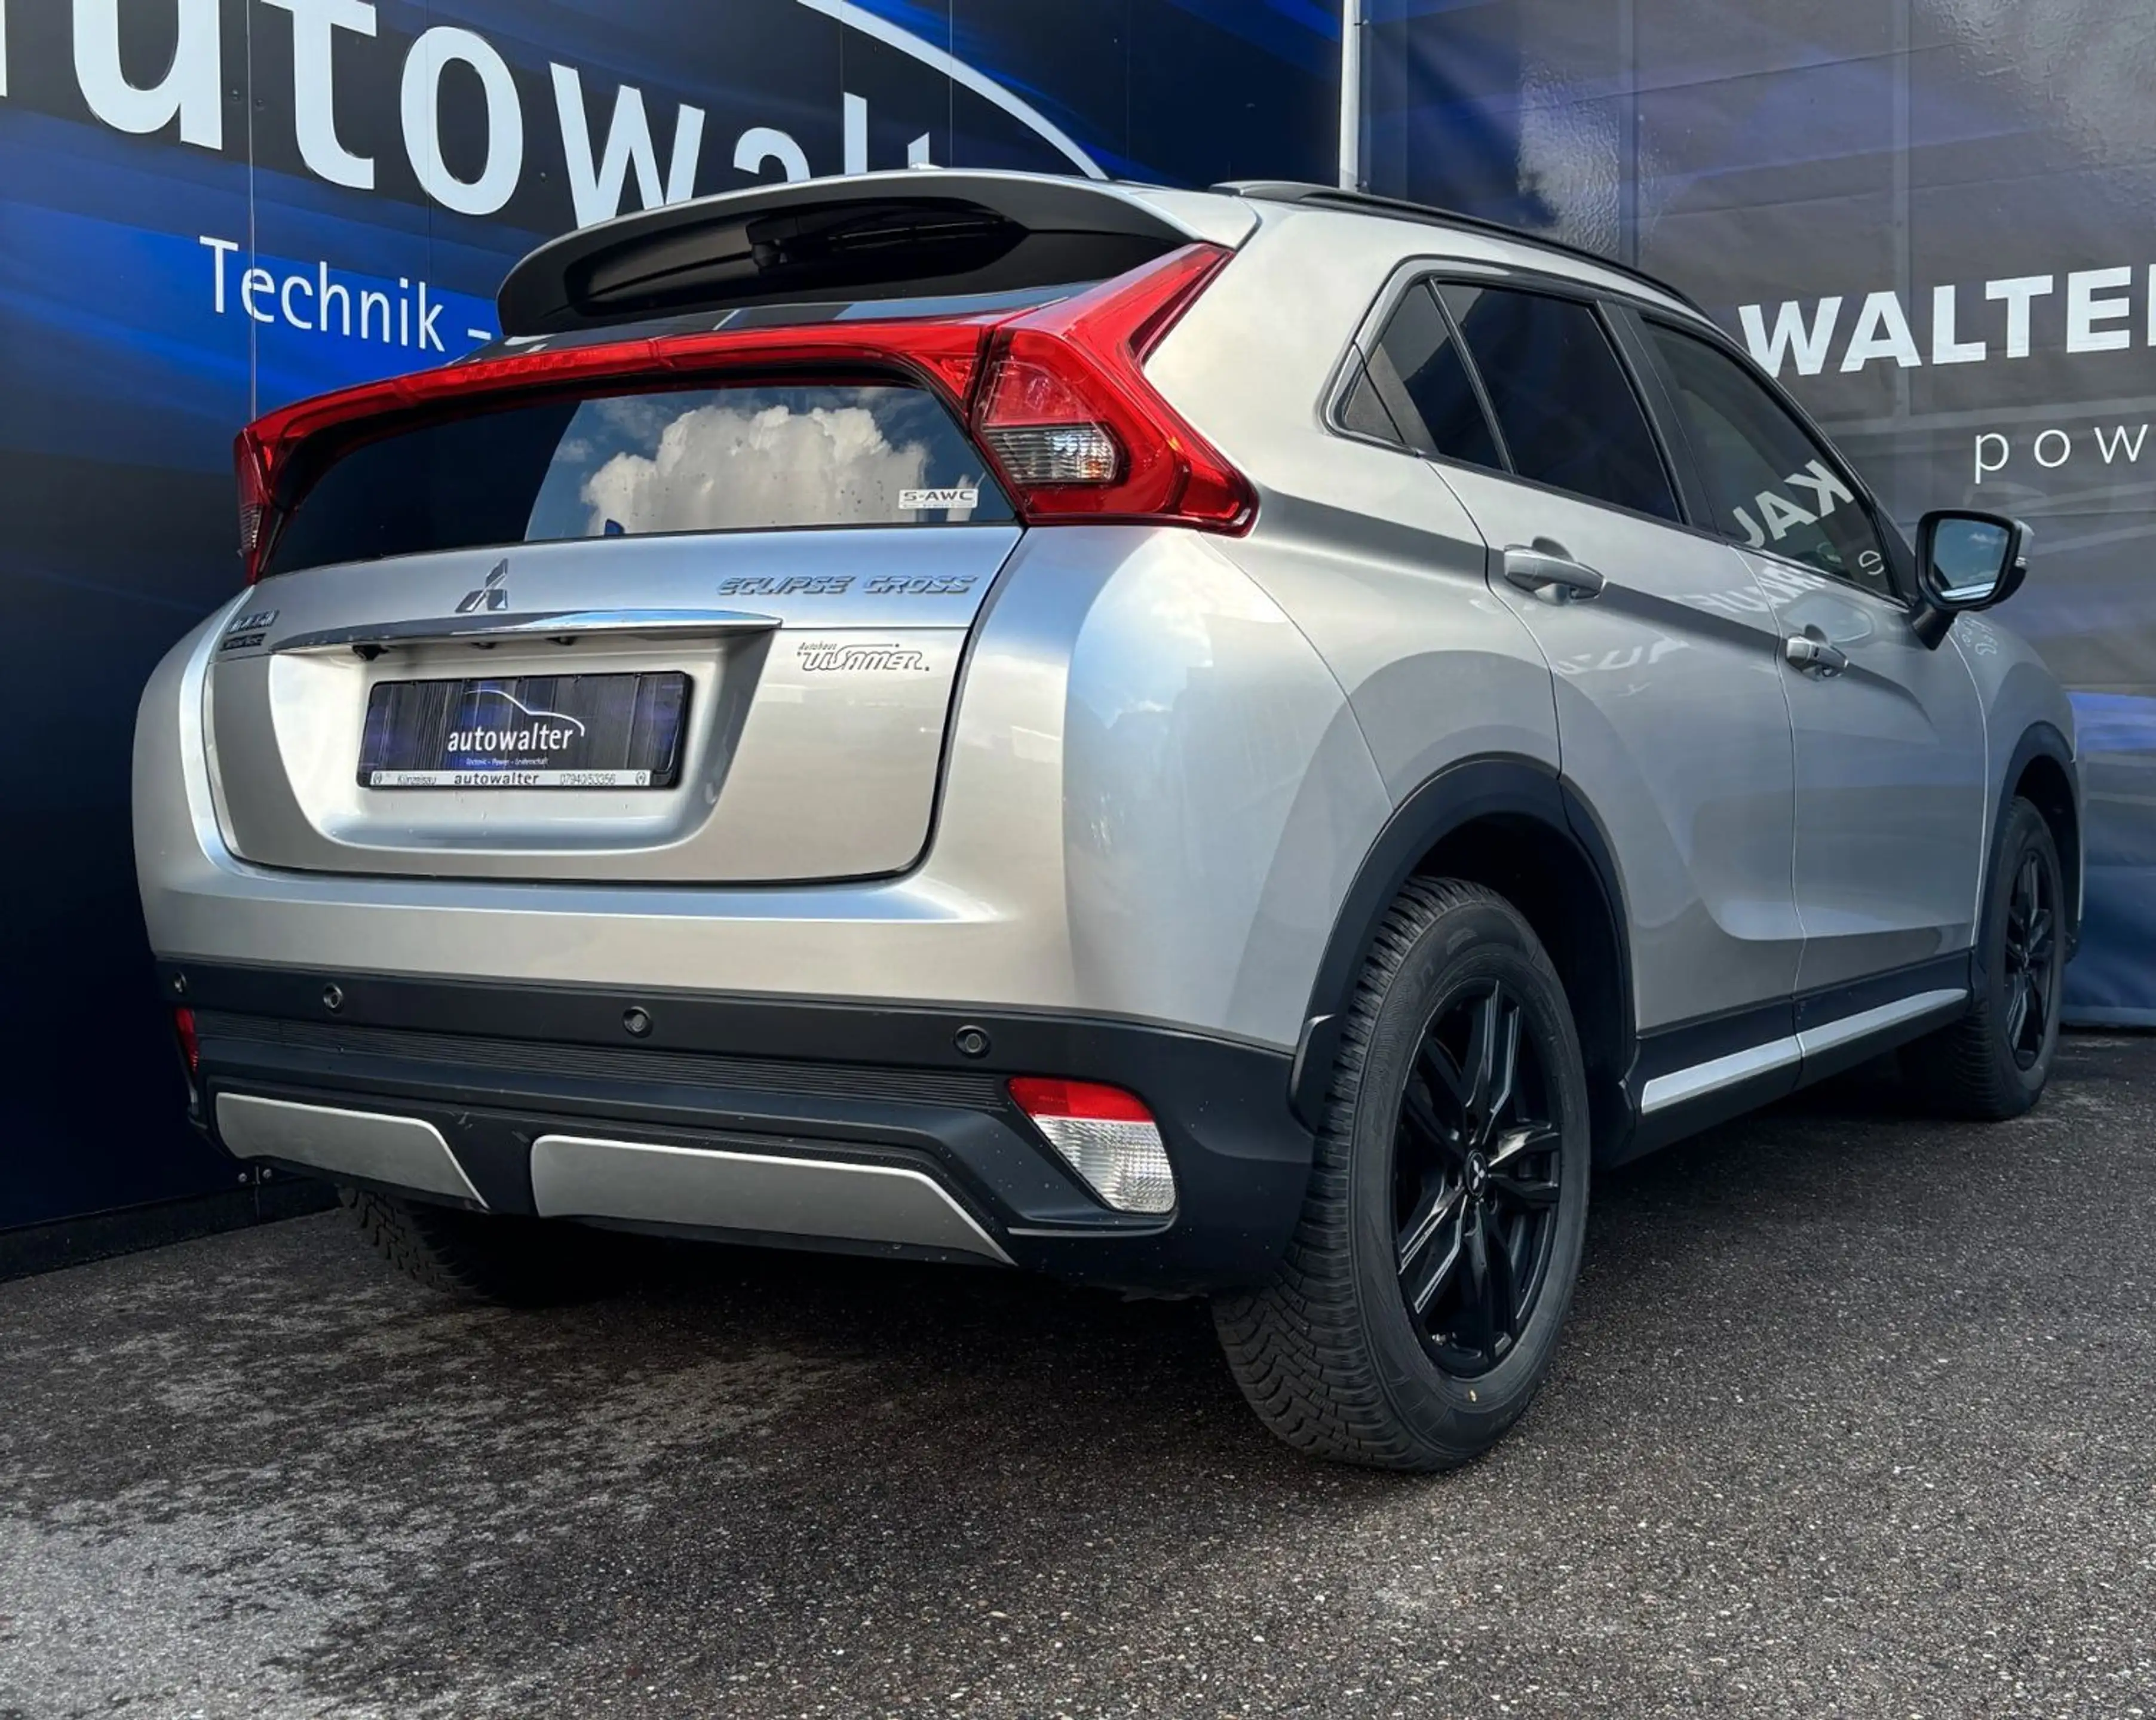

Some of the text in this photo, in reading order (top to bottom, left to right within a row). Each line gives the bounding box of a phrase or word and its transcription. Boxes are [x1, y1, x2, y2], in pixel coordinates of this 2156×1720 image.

[0, 0, 930, 230] utow
[200, 235, 445, 352] Technik
[1738, 263, 2156, 379] WALTE
[903, 490, 974, 502] S-AWC
[719, 575, 979, 595] ECLIPSE CROSS
[447, 722, 573, 752] autowalter
[454, 772, 539, 785] autowalter
